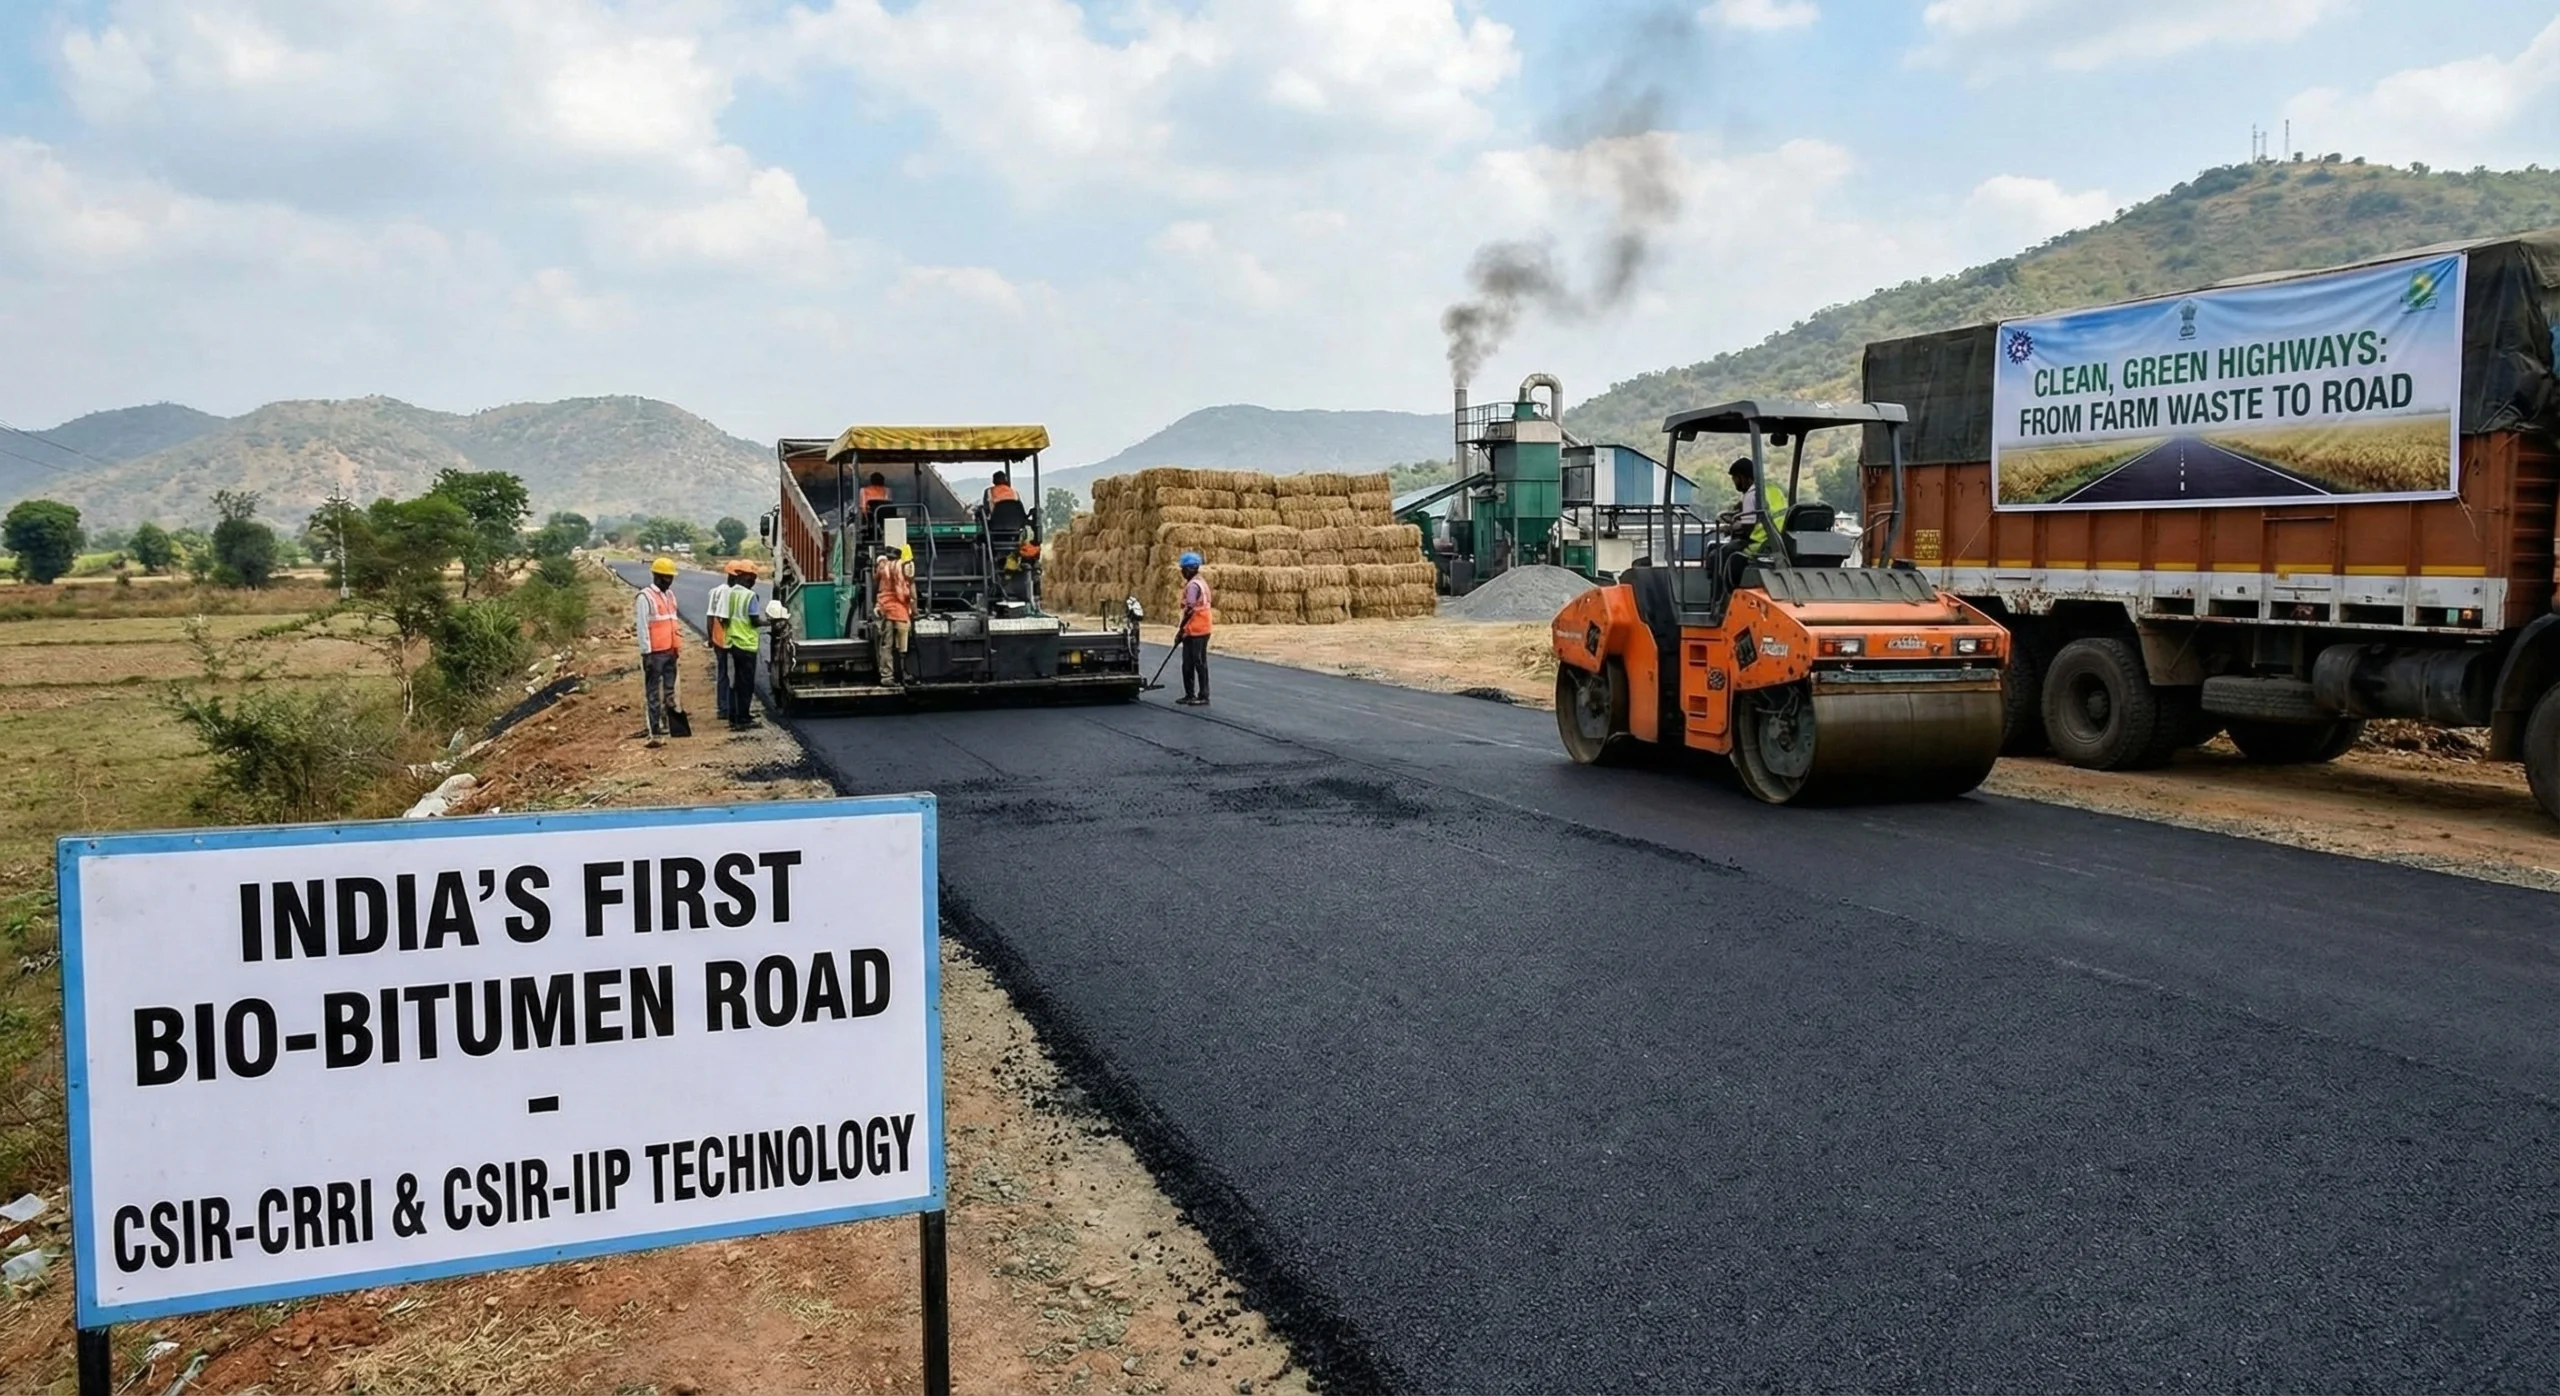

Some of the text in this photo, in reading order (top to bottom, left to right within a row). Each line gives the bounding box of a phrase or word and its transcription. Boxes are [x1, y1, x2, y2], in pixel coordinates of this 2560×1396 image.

[2020, 373, 2413, 437] FROM FARM WASTE TO ROAD
[2034, 330, 2388, 397] CLEAN, GREEN HIGHWAYS:
[239, 850, 802, 963] INDIA'S FIRST
[134, 948, 891, 1087] BIO-BITUMEN ROAD
[113, 1113, 915, 1273] CSIR-CRRI & CSIR-IIP TECHNOLOGY
